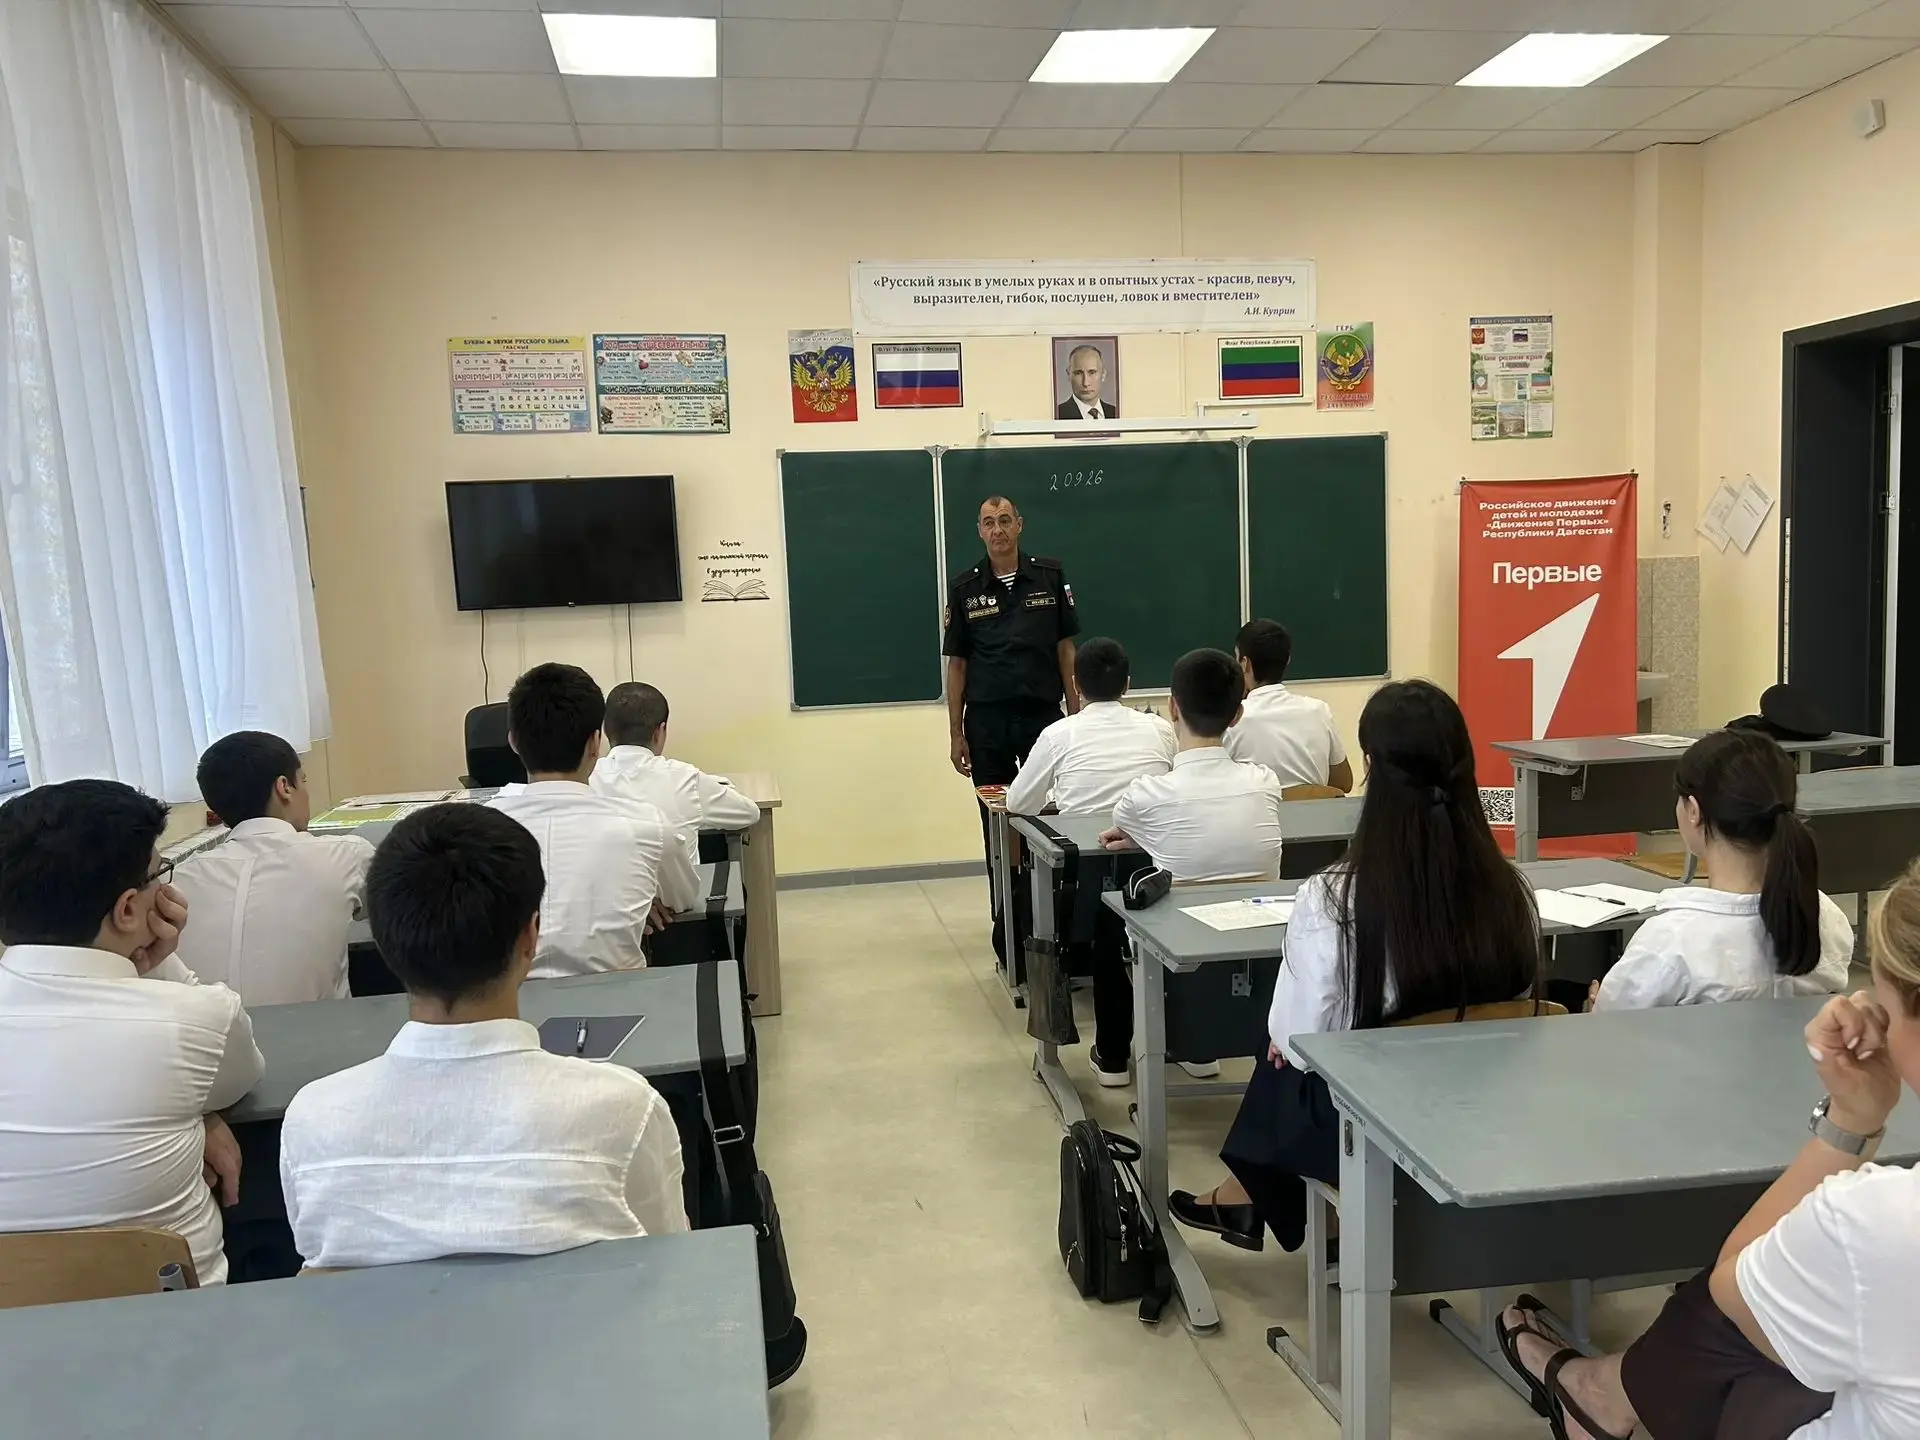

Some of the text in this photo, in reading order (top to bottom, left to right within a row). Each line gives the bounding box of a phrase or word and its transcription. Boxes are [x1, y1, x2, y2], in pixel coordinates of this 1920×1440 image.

[873, 276, 935, 290] «Русский
[938, 277, 971, 287] язык
[974, 277, 982, 287] в
[985, 277, 1035, 289] умелых
[1038, 276, 1075, 289] руках
[1078, 276, 1086, 286] и
[1089, 276, 1096, 286] в
[1099, 276, 1158, 286] опытных
[1160, 275, 1195, 287] устах
[1207, 275, 1254, 287] красив,
[1257, 275, 1296, 286] певуч,
[913, 291, 1260, 306] выразителен, гибок, послушен, ловок и вместителен»
[1244, 306, 1296, 317] А.И. Куприн
[605, 385, 628, 393] ЧИСЛО
[645, 385, 712, 393] СУЩЕСТВИТЕЛЬНЫХ
[1480, 498, 1617, 510] Российское движение
[1492, 509, 1603, 520] детей и молодежи
[1487, 518, 1609, 529] «Движение Первых»
[1482, 527, 1613, 539] Республики Дагестан
[1493, 562, 1602, 590] Первые
